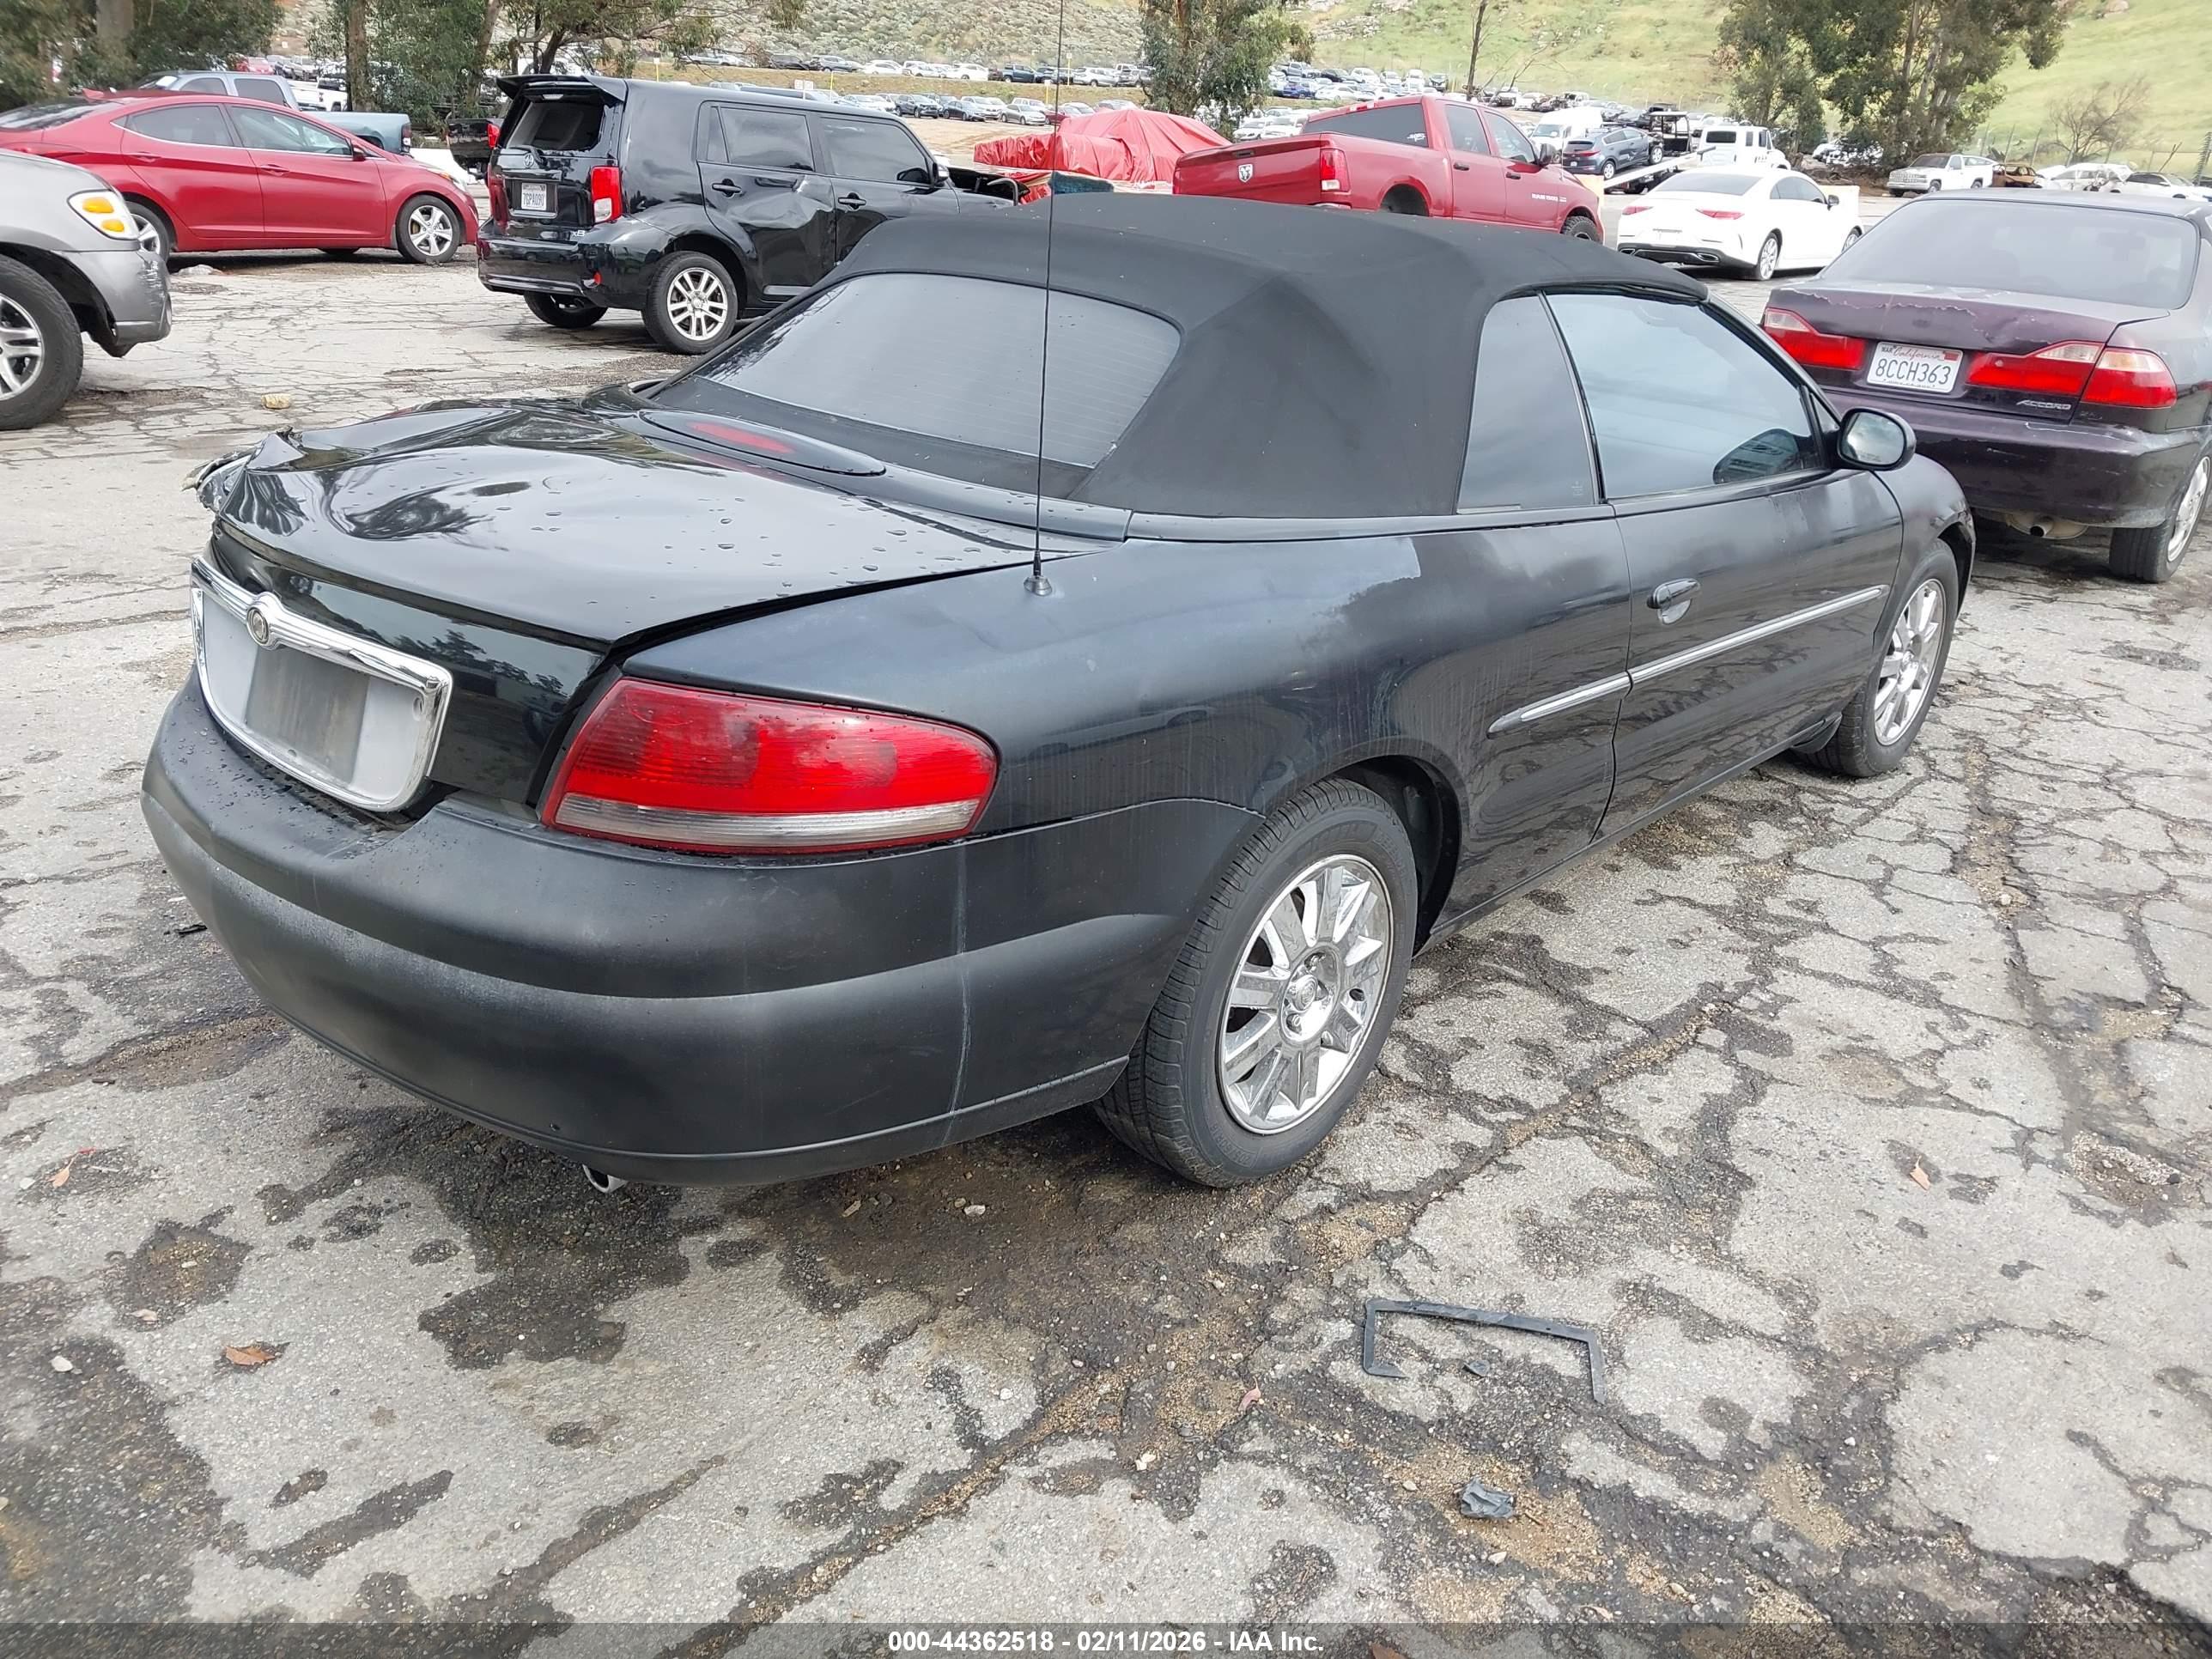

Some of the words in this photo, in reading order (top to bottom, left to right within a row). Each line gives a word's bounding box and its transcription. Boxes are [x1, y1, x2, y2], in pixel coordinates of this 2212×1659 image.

[1893, 345, 1941, 361] California
[1875, 357, 1952, 386] 8CCH363
[2015, 399, 2072, 410] ACCORD
